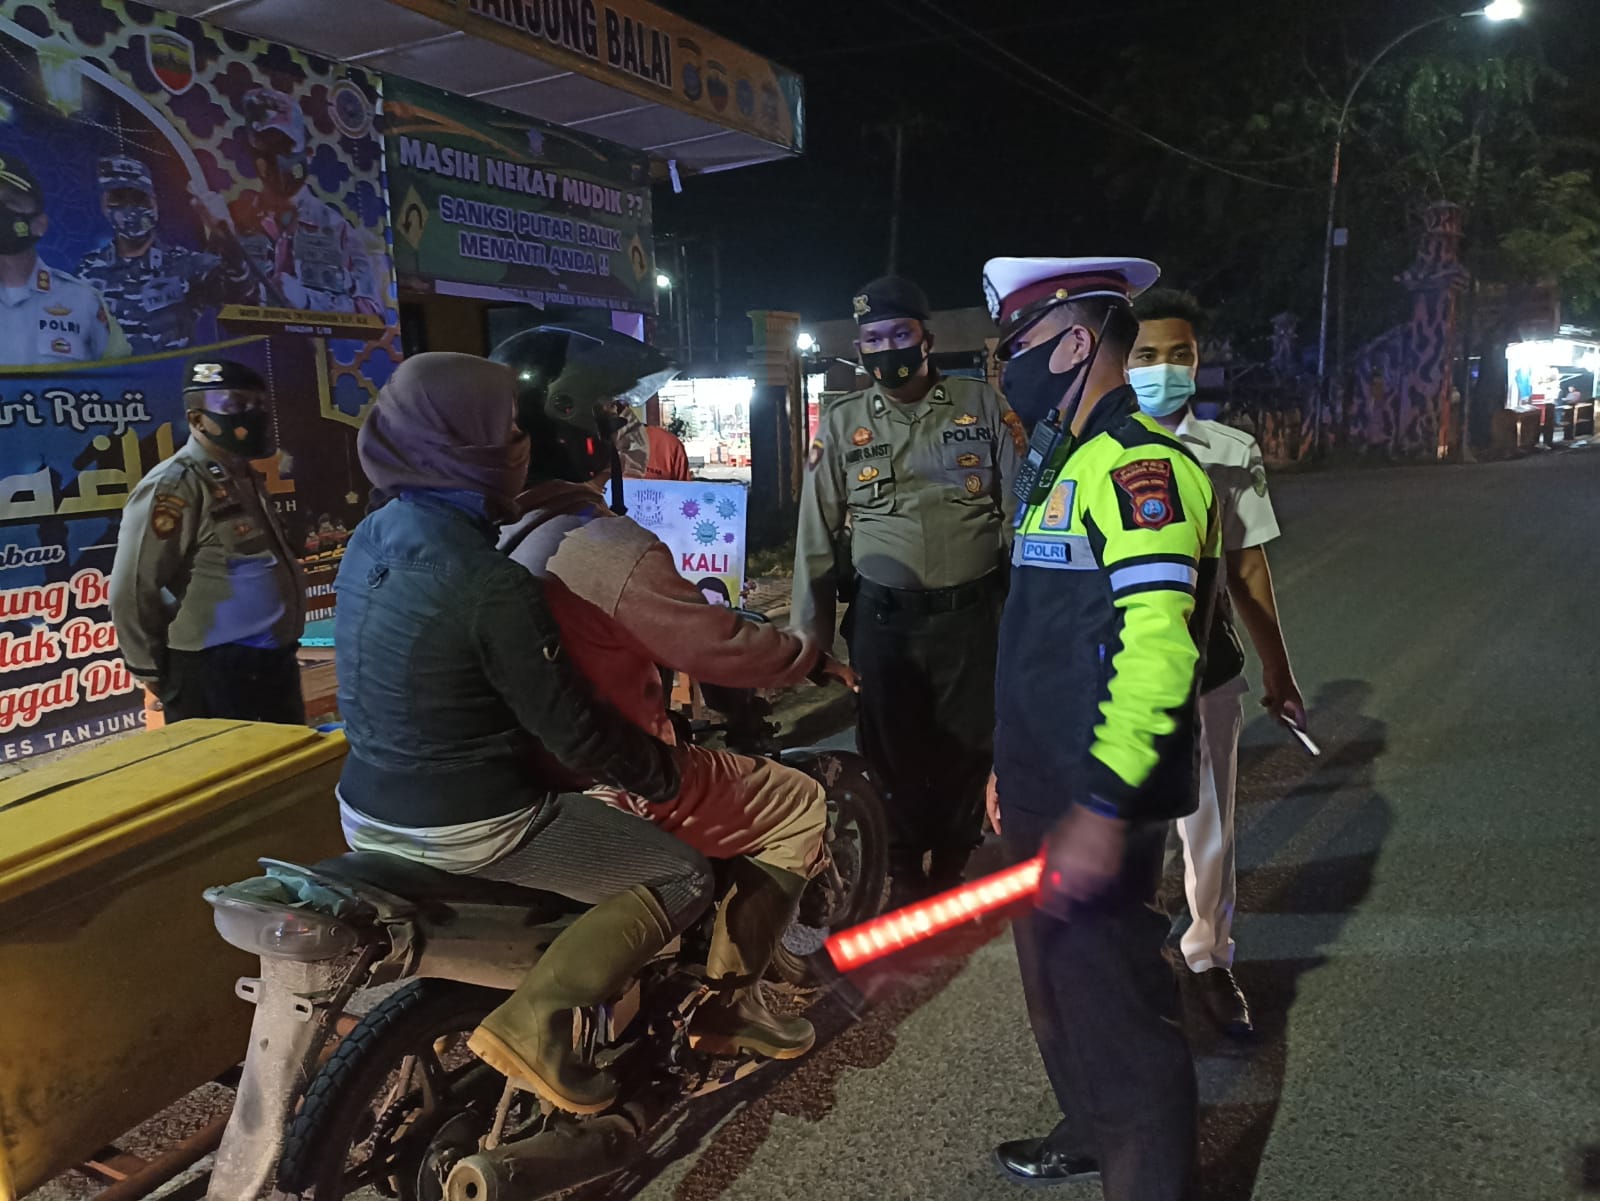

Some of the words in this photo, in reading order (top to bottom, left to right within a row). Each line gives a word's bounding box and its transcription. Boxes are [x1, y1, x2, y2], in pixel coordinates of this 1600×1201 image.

[605, 7, 673, 89] BALAI
[399, 136, 480, 183] MASIH
[486, 158, 557, 199] NEKAT
[562, 177, 623, 214] MUDIK
[627, 194, 643, 218] ??
[439, 195, 514, 232] SANKSI
[519, 211, 574, 242] PUTAR
[578, 223, 622, 251] BALIK
[459, 231, 546, 265] MENANTI
[549, 246, 596, 273] ANDA
[599, 255, 610, 276] !!
[39, 319, 80, 334] POLRI
[0, 392, 43, 425] ri
[942, 427, 991, 444] POLRI
[681, 552, 728, 572] KALI
[1026, 543, 1064, 559] POLRI
[0, 739, 34, 761] ES
